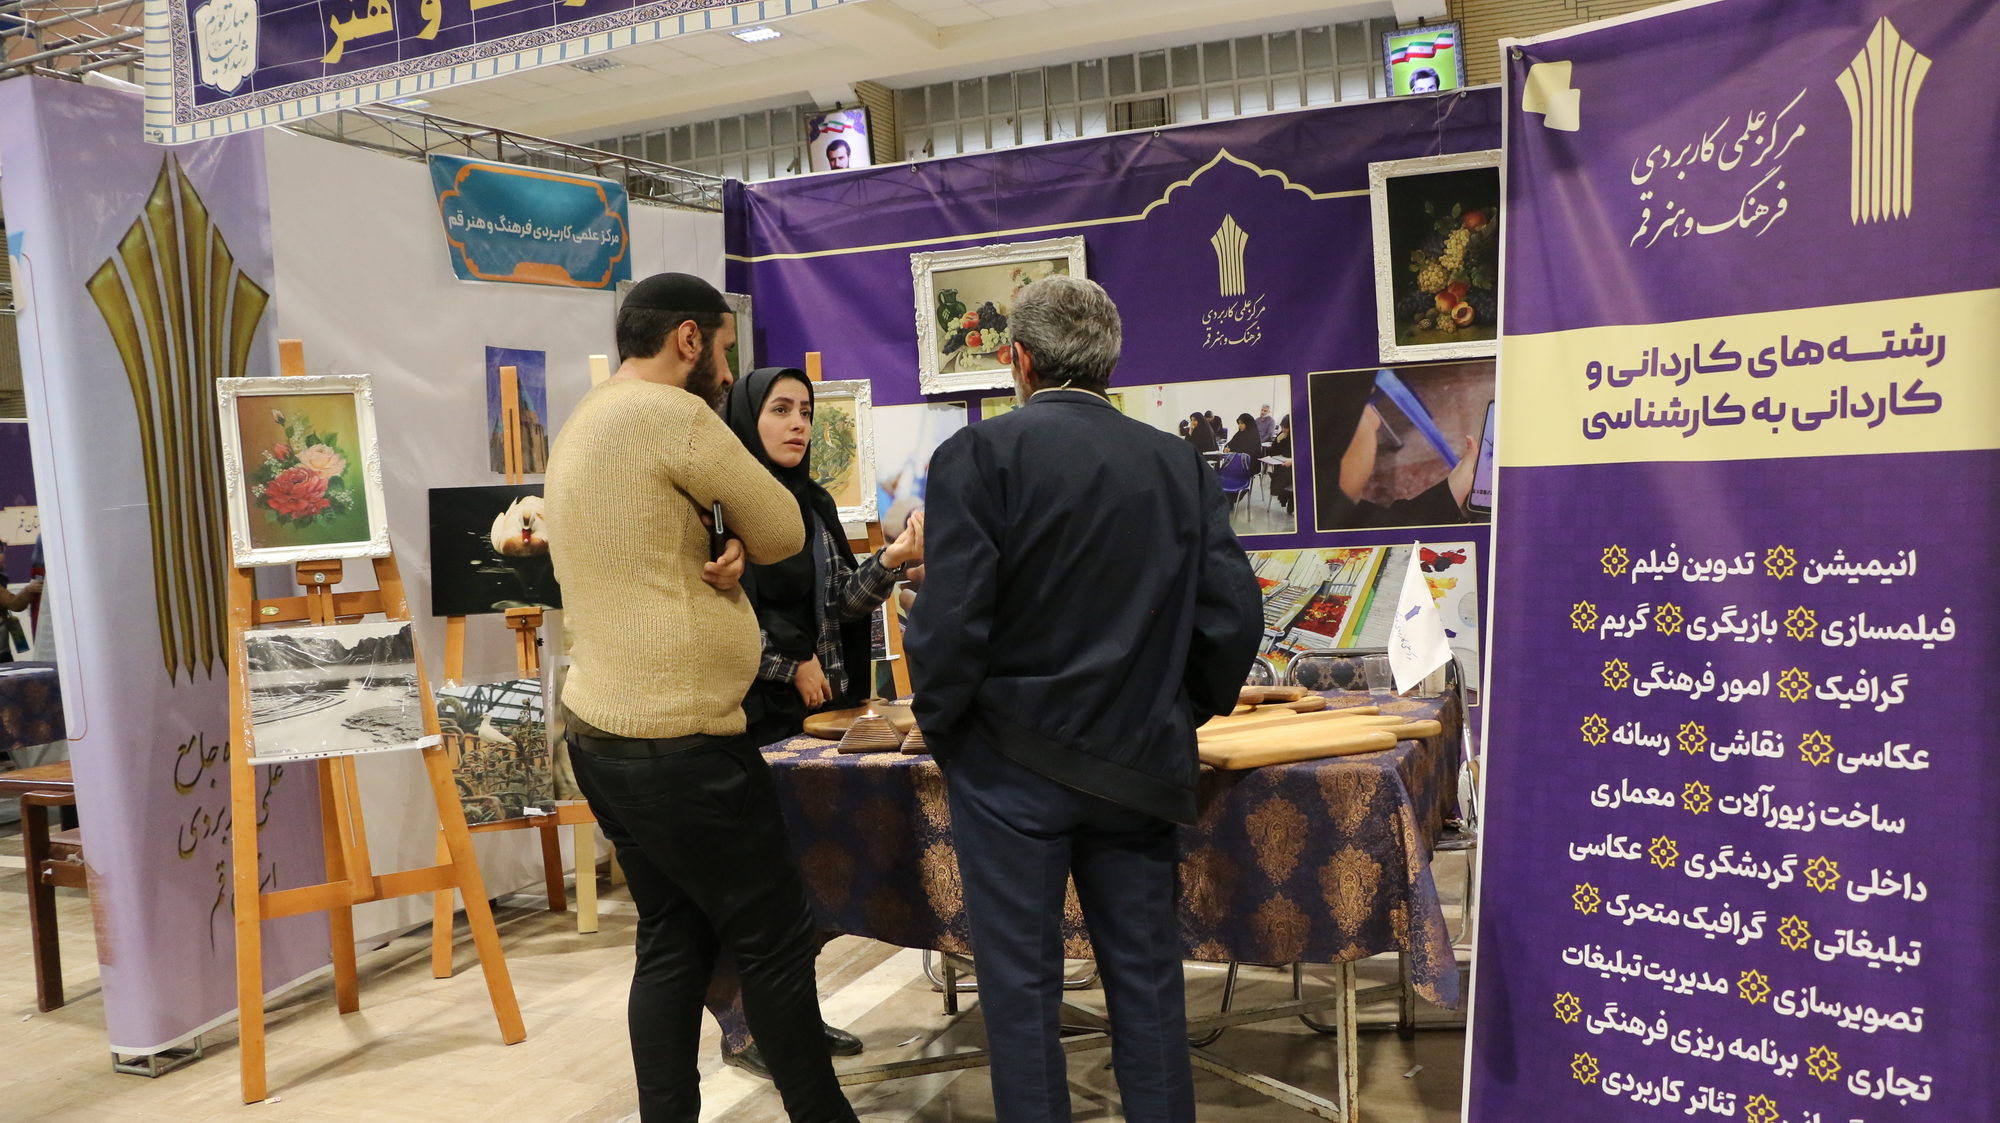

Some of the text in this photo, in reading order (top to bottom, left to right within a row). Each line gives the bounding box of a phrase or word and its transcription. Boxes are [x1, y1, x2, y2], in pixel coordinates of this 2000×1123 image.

[415, 0, 443, 40] و
[1631, 88, 1807, 185] مرکز علمی کاربردی
[448, 210, 463, 230] قم
[465, 216, 486, 231] هنر
[494, 215, 532, 238] فرهنگ
[1630, 165, 1787, 248] فرهنگ و هنر قم
[533, 225, 573, 242] کاربردی
[572, 228, 599, 243] علمی
[600, 229, 619, 246] مرکز
[1202, 293, 1265, 325] مرکز علمی کاربردی
[1202, 327, 1211, 348] قم
[1209, 331, 1224, 349] هنر
[1228, 320, 1261, 346] فرهنگ
[1586, 361, 1601, 390] و
[1608, 340, 1741, 387] کاردانی
[1583, 379, 1942, 439] کاردانی به کارشناسی
[1632, 543, 1916, 584] انیمیشن تدوین فیلم
[1601, 603, 1955, 649] فیلمسازی بازیگری گریم
[1633, 662, 1908, 712] گرافیک امور فرهنگی
[1612, 722, 1929, 773] عکاسی نقاشی رسانه
[1591, 778, 1905, 833] ساخت زیورآلات معماری
[1569, 834, 1927, 902] داخلی گردشگری عکاسی
[210, 860, 225, 956] قم
[1606, 895, 1921, 972] تبلیغاتی گرافیک متحرک
[1562, 944, 1923, 1033] تصویرسازی مدیریت تبلیغات
[1587, 1003, 1668, 1045] فرهنگی
[1602, 1072, 1736, 1116] تئاتر کاربردی
[1848, 1067, 1932, 1105] تجاری
